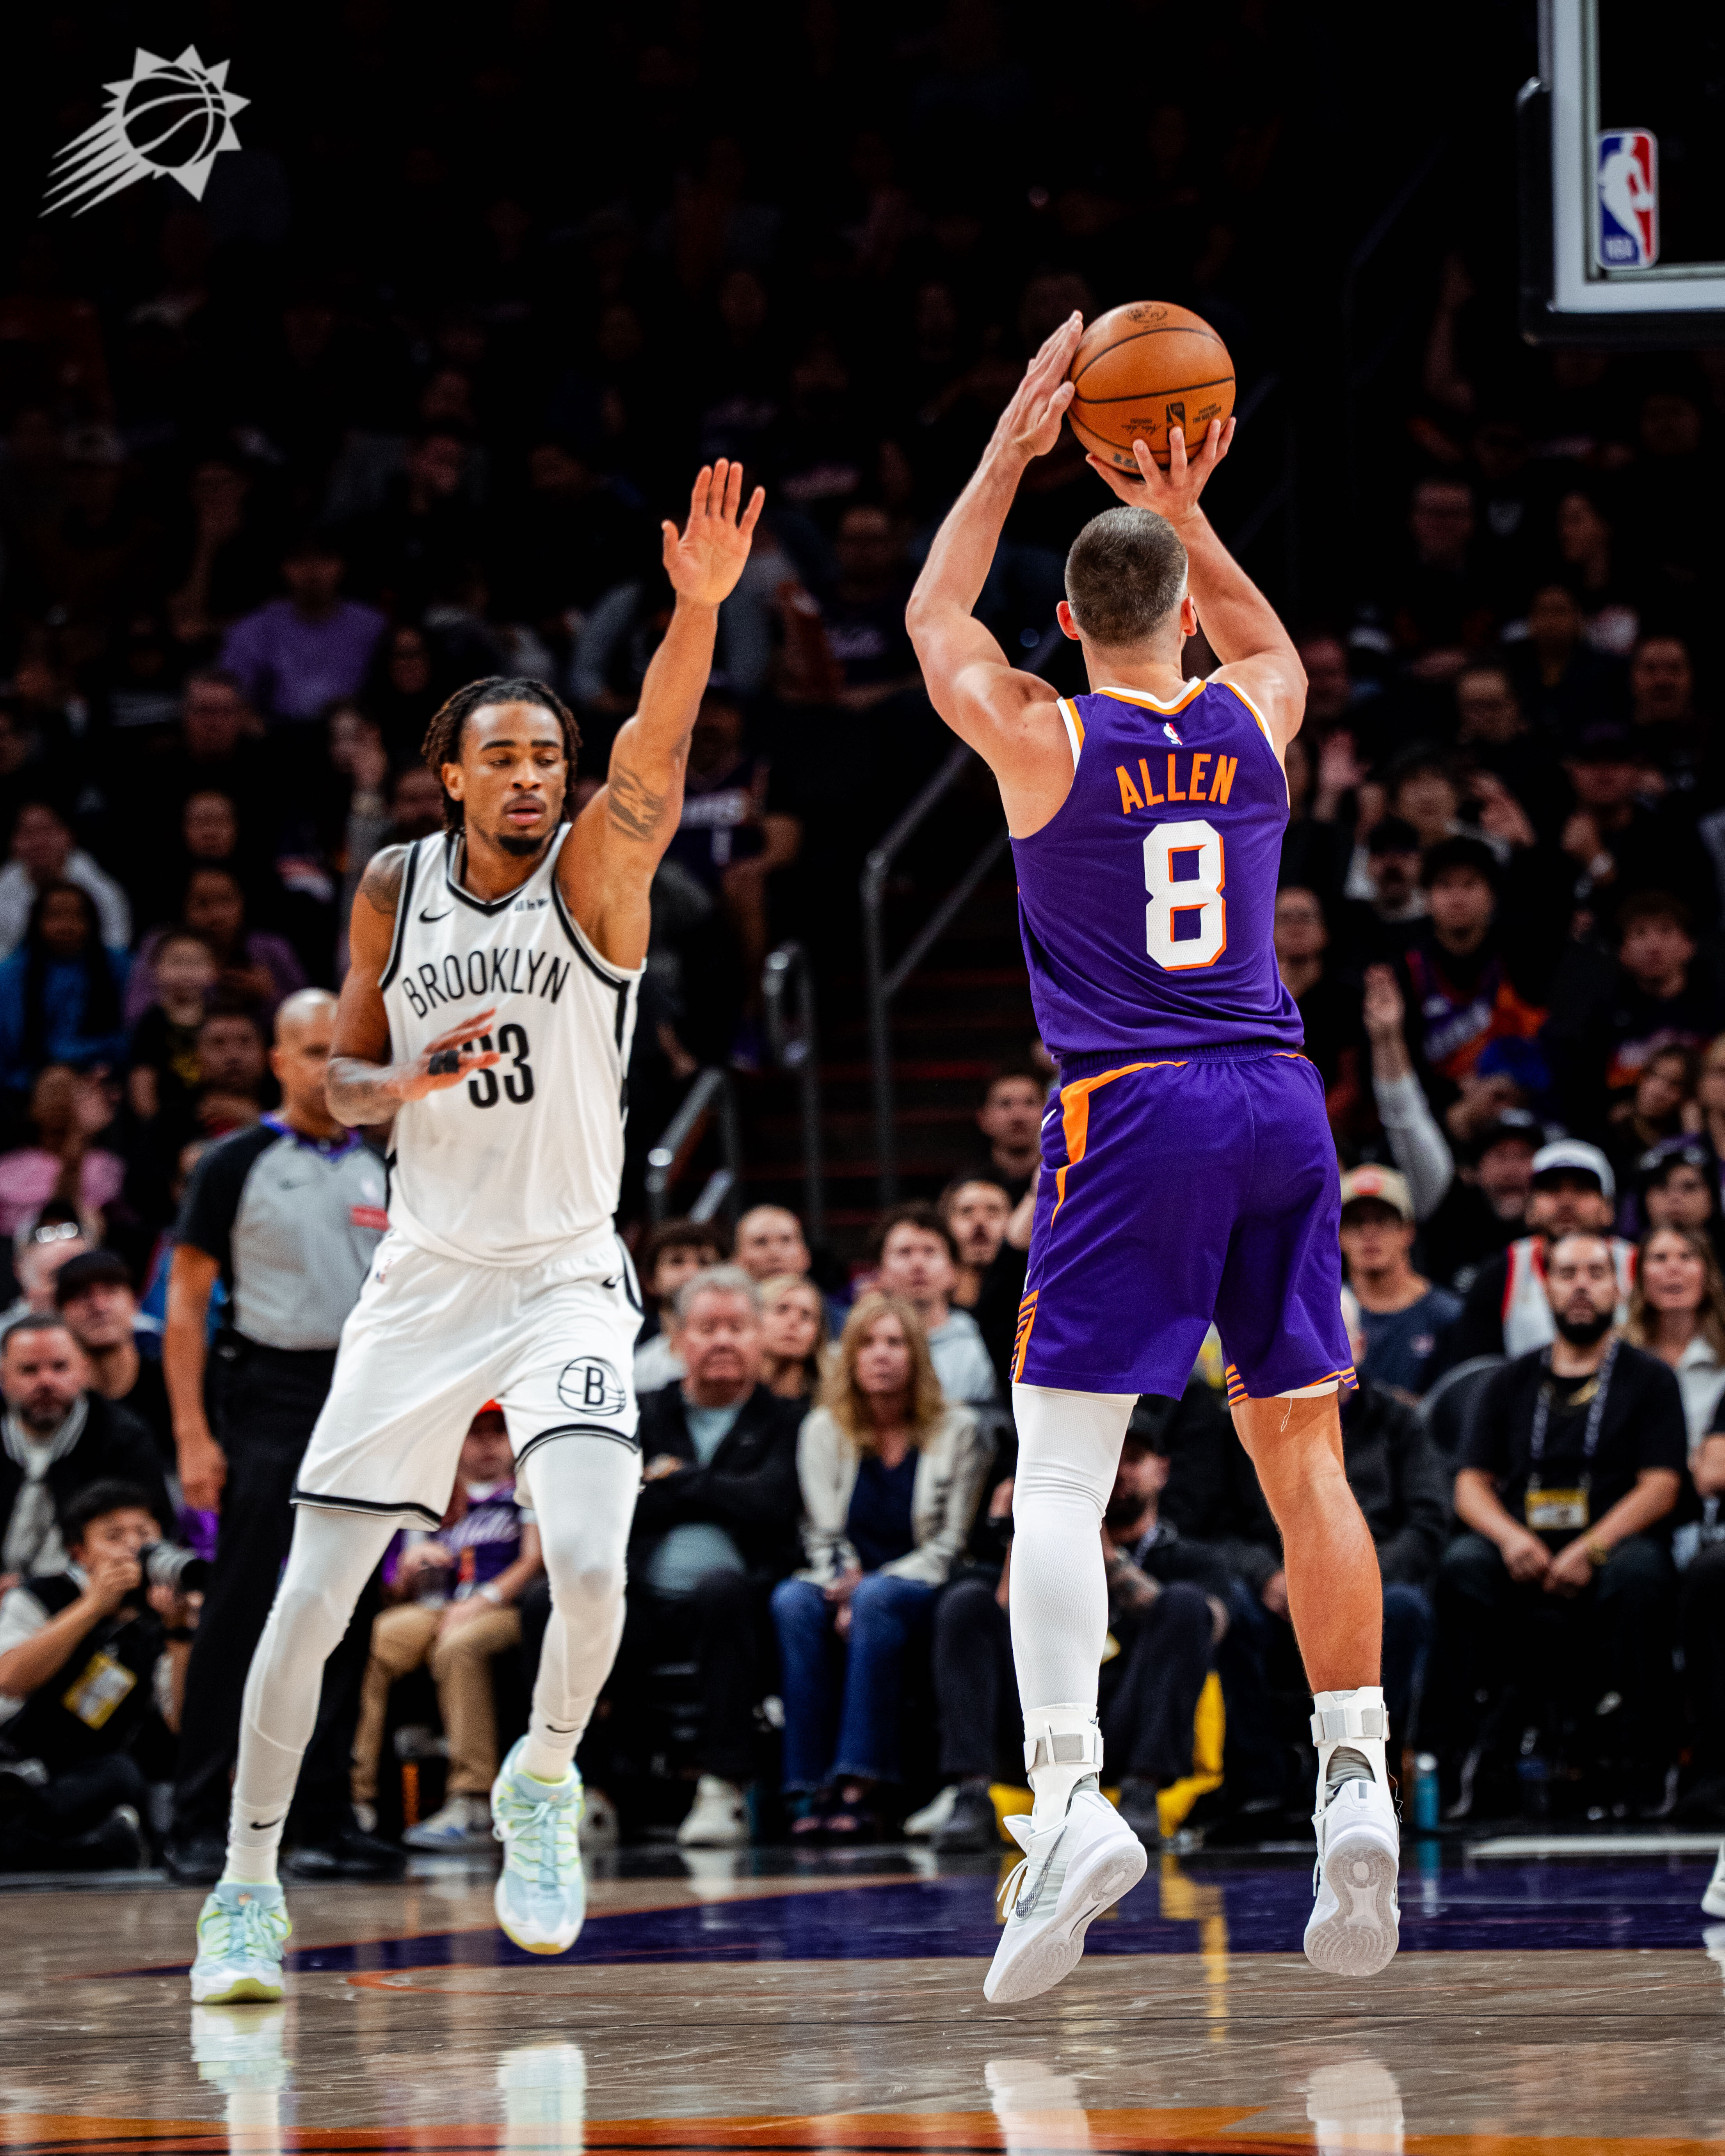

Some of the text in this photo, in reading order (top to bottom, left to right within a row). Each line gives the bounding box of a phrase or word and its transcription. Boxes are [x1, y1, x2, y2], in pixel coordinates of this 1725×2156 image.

[1116, 753, 1238, 814] ALLEN
[1143, 819, 1227, 971] 8
[402, 948, 571, 1018] BROOKLYN
[584, 1366, 605, 1406] B
